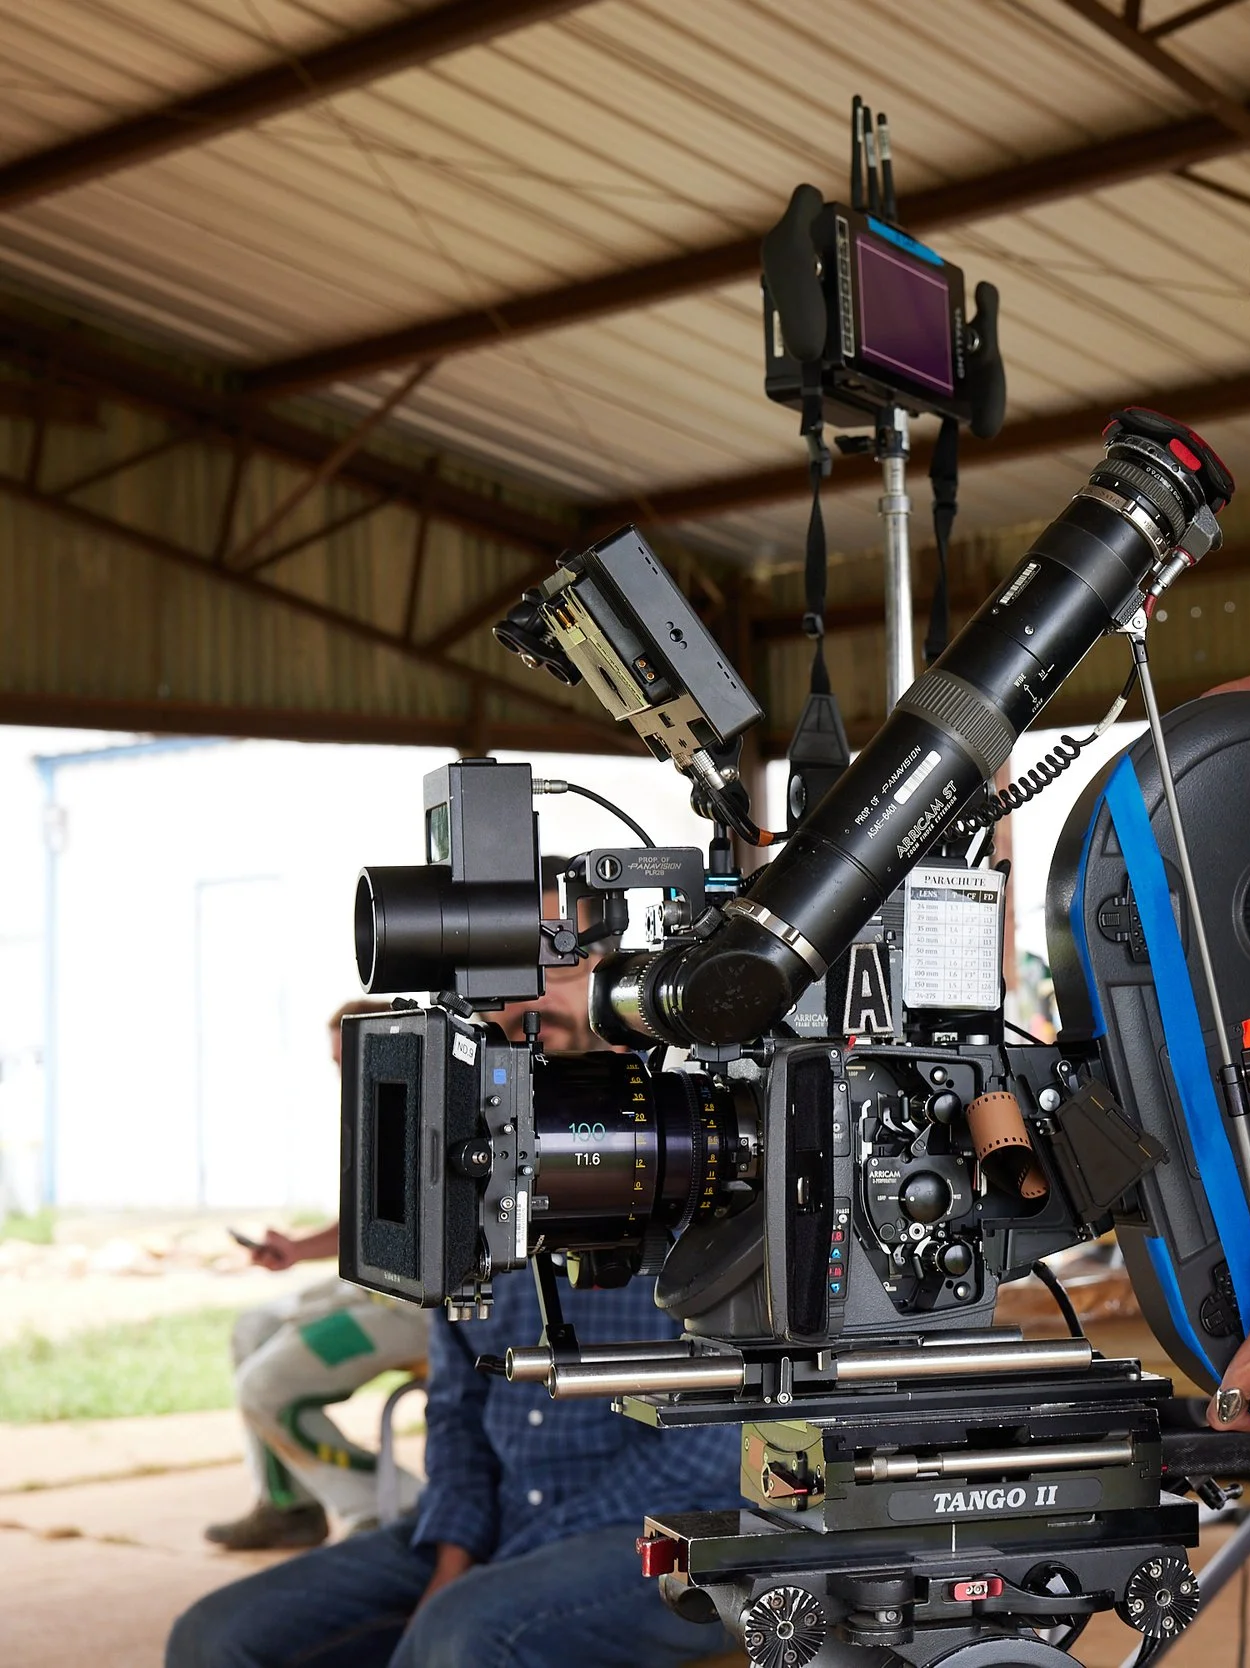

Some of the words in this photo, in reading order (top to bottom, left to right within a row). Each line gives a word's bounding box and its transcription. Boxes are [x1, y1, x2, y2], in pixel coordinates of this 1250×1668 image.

[1014, 672, 1027, 688] WIDE
[854, 806, 874, 826] PROP.
[870, 795, 880, 807] OF
[881, 745, 922, 794] PANAVISION
[896, 798, 944, 859] ARRICAM
[942, 780, 957, 800] ST
[906, 842, 920, 858] ZOOM
[920, 824, 935, 842] FINDER
[934, 795, 958, 823] EXTENSION
[924, 875, 986, 887] PARACHUTE
[919, 890, 938, 898] LENS
[842, 944, 894, 1035] A
[568, 1122, 606, 1142] 100
[575, 1153, 600, 1166] T1.6
[933, 1488, 1026, 1513] TANGO
[1034, 1486, 1058, 1506] II
